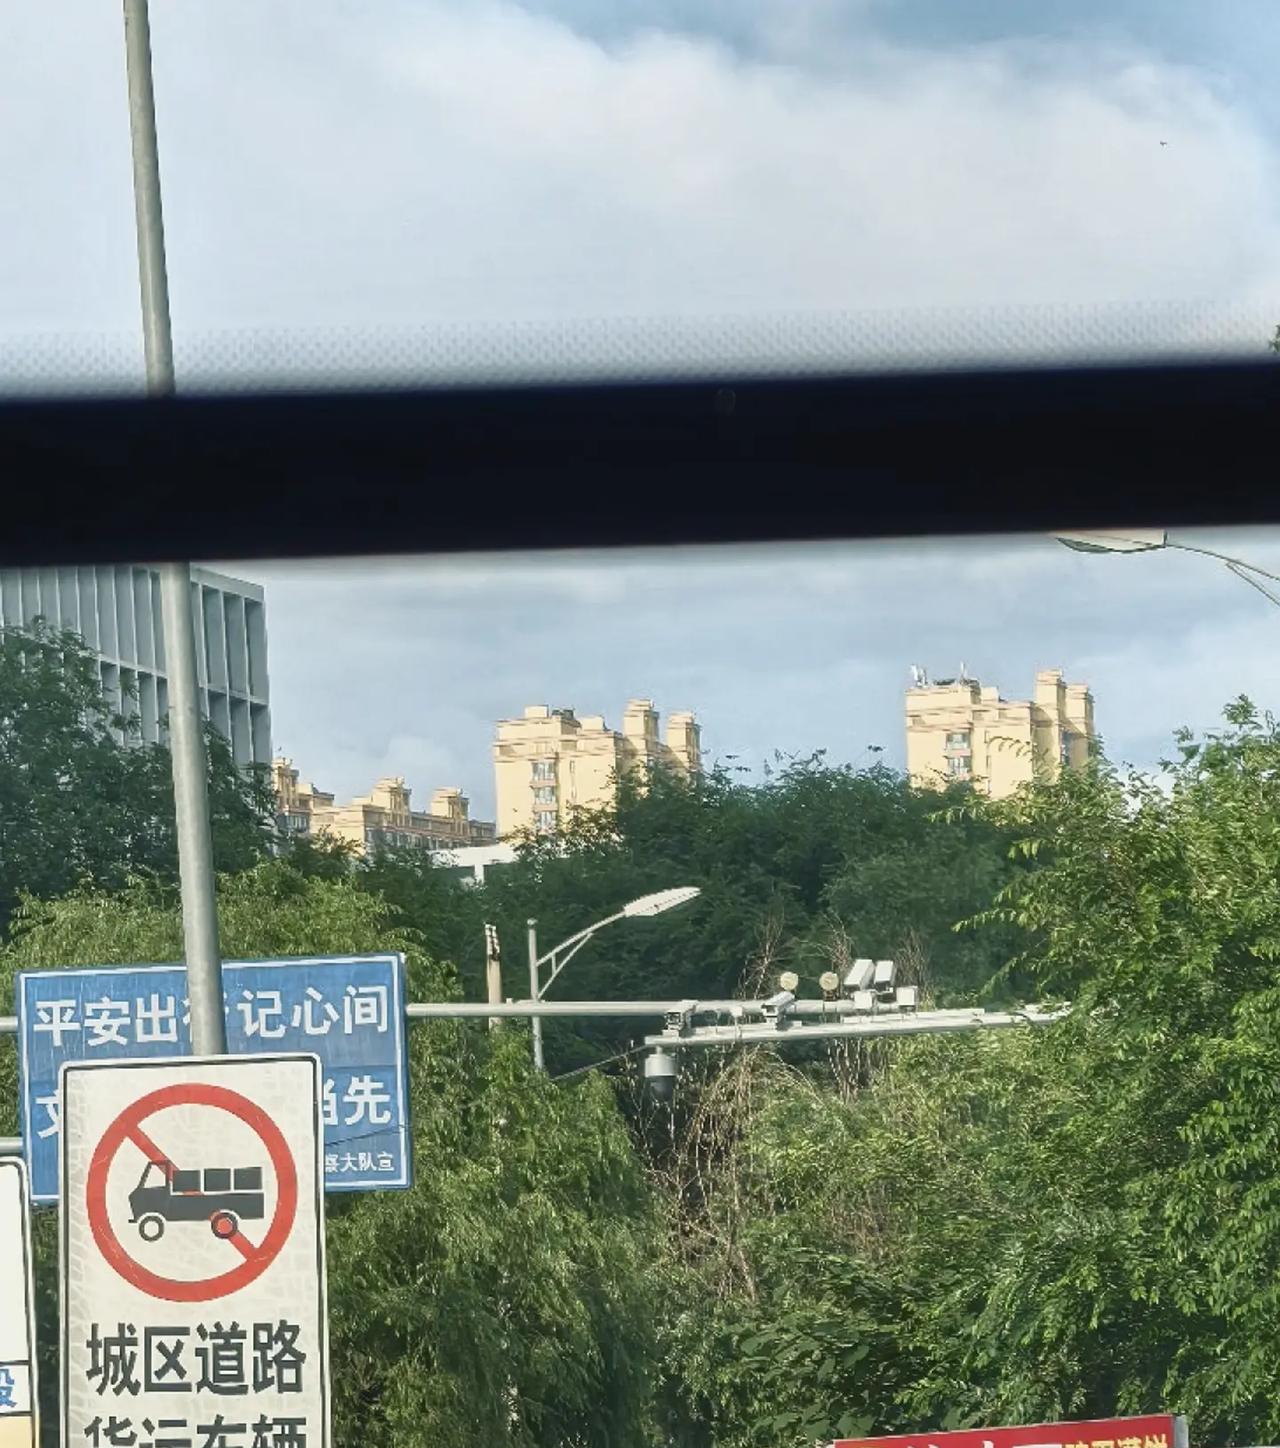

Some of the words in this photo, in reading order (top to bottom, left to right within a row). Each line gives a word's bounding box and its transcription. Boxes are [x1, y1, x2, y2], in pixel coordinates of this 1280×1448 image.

[33, 985, 389, 1047] 平安出记心间
[86, 1319, 307, 1397] 城区道路
